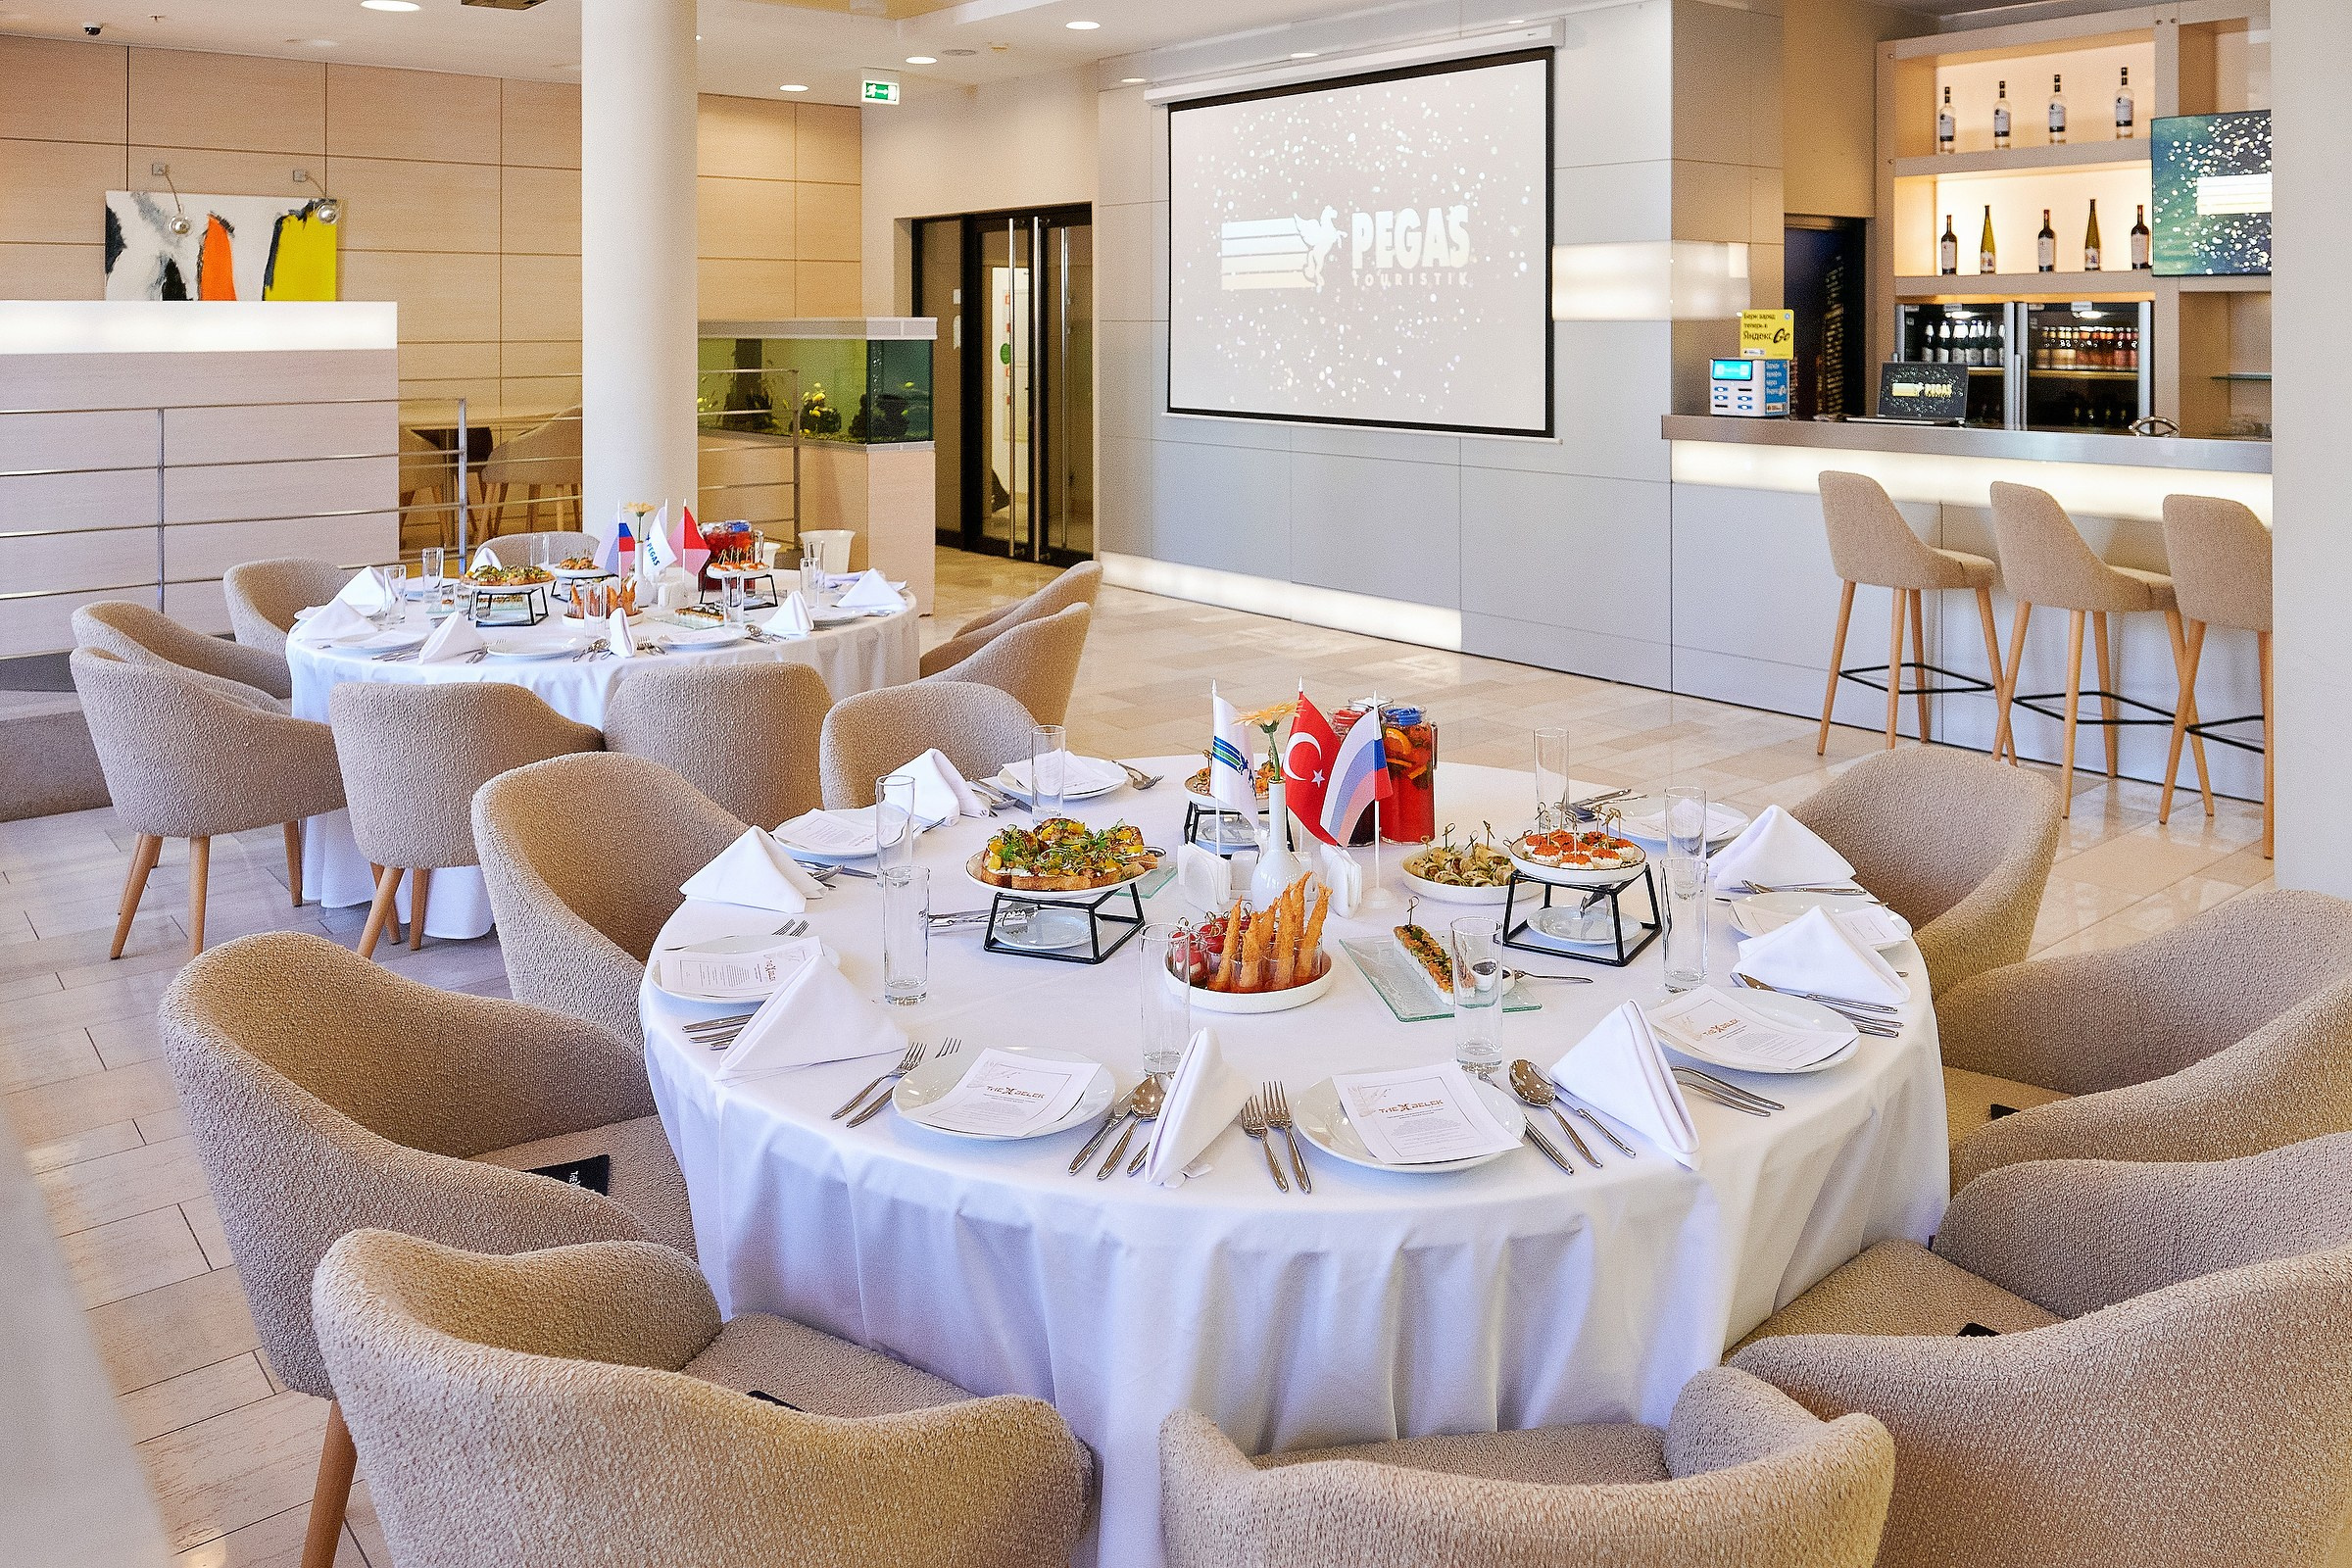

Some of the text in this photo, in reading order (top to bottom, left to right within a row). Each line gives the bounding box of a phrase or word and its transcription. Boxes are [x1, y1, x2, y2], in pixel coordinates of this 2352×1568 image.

[1351, 204, 1470, 270] PEGAS
[1351, 271, 1469, 287] TOURISTIK
[1743, 328, 1790, 343] Яндекс Go
[647, 543, 660, 565] PEGAS
